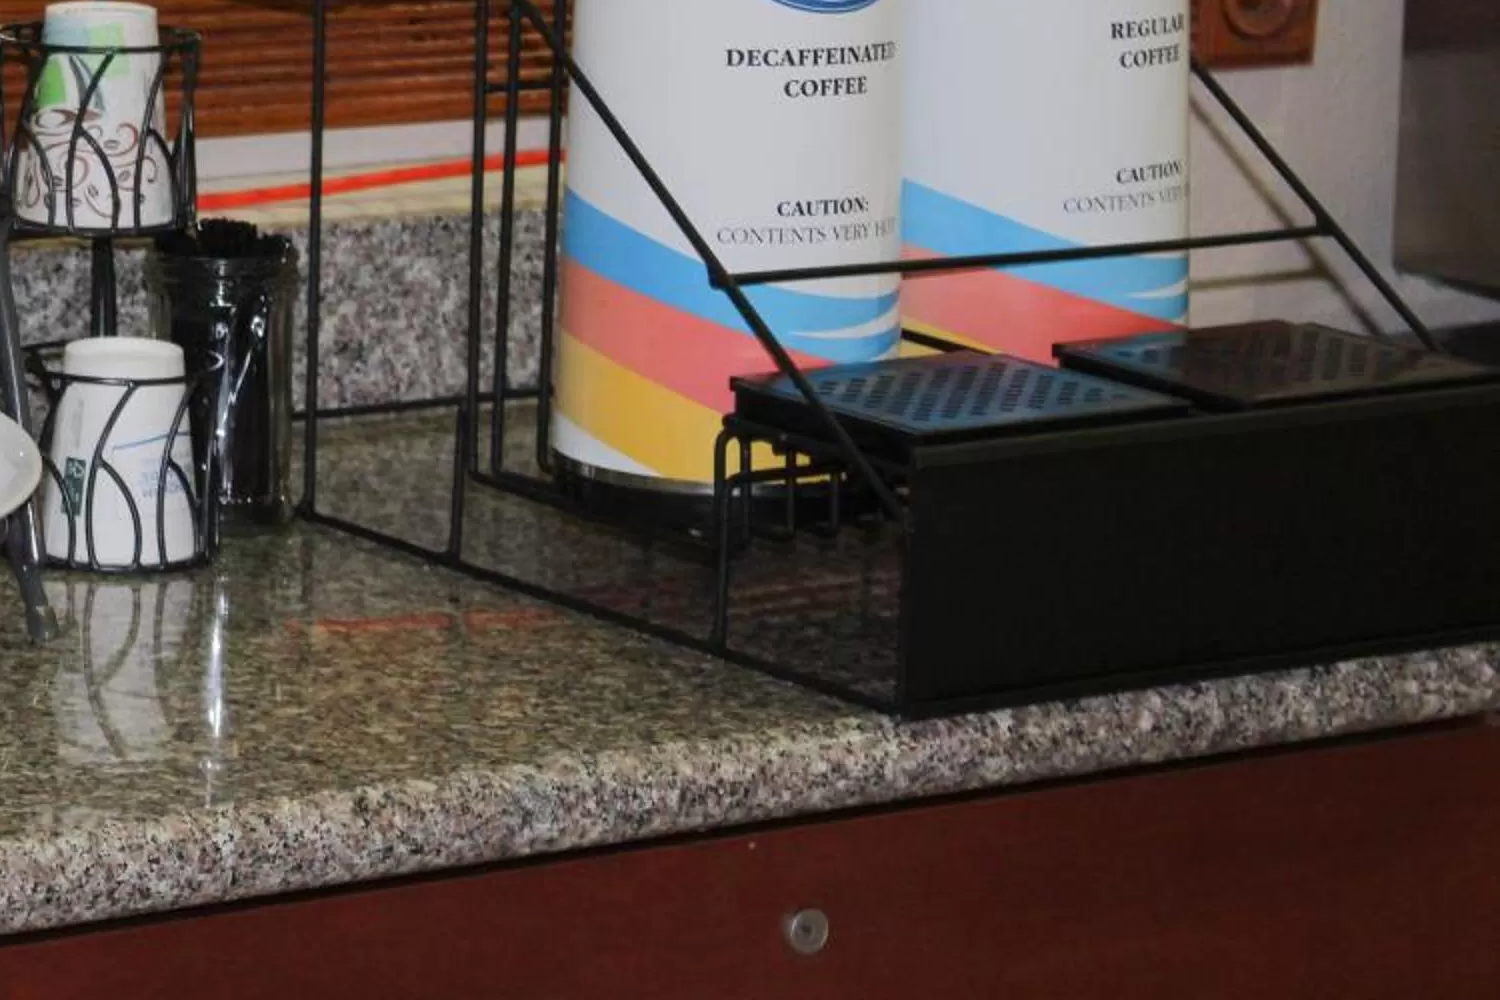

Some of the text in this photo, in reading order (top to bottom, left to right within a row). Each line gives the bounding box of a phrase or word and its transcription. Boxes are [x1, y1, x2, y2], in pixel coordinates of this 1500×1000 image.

[1119, 44, 1181, 69] COFFEE
[783, 76, 868, 98] COFFEE
[776, 196, 869, 217] CAUTION:
[1063, 191, 1155, 213] CONTENTS
[716, 226, 827, 246] CONTENTS
[832, 221, 869, 242] VERY
